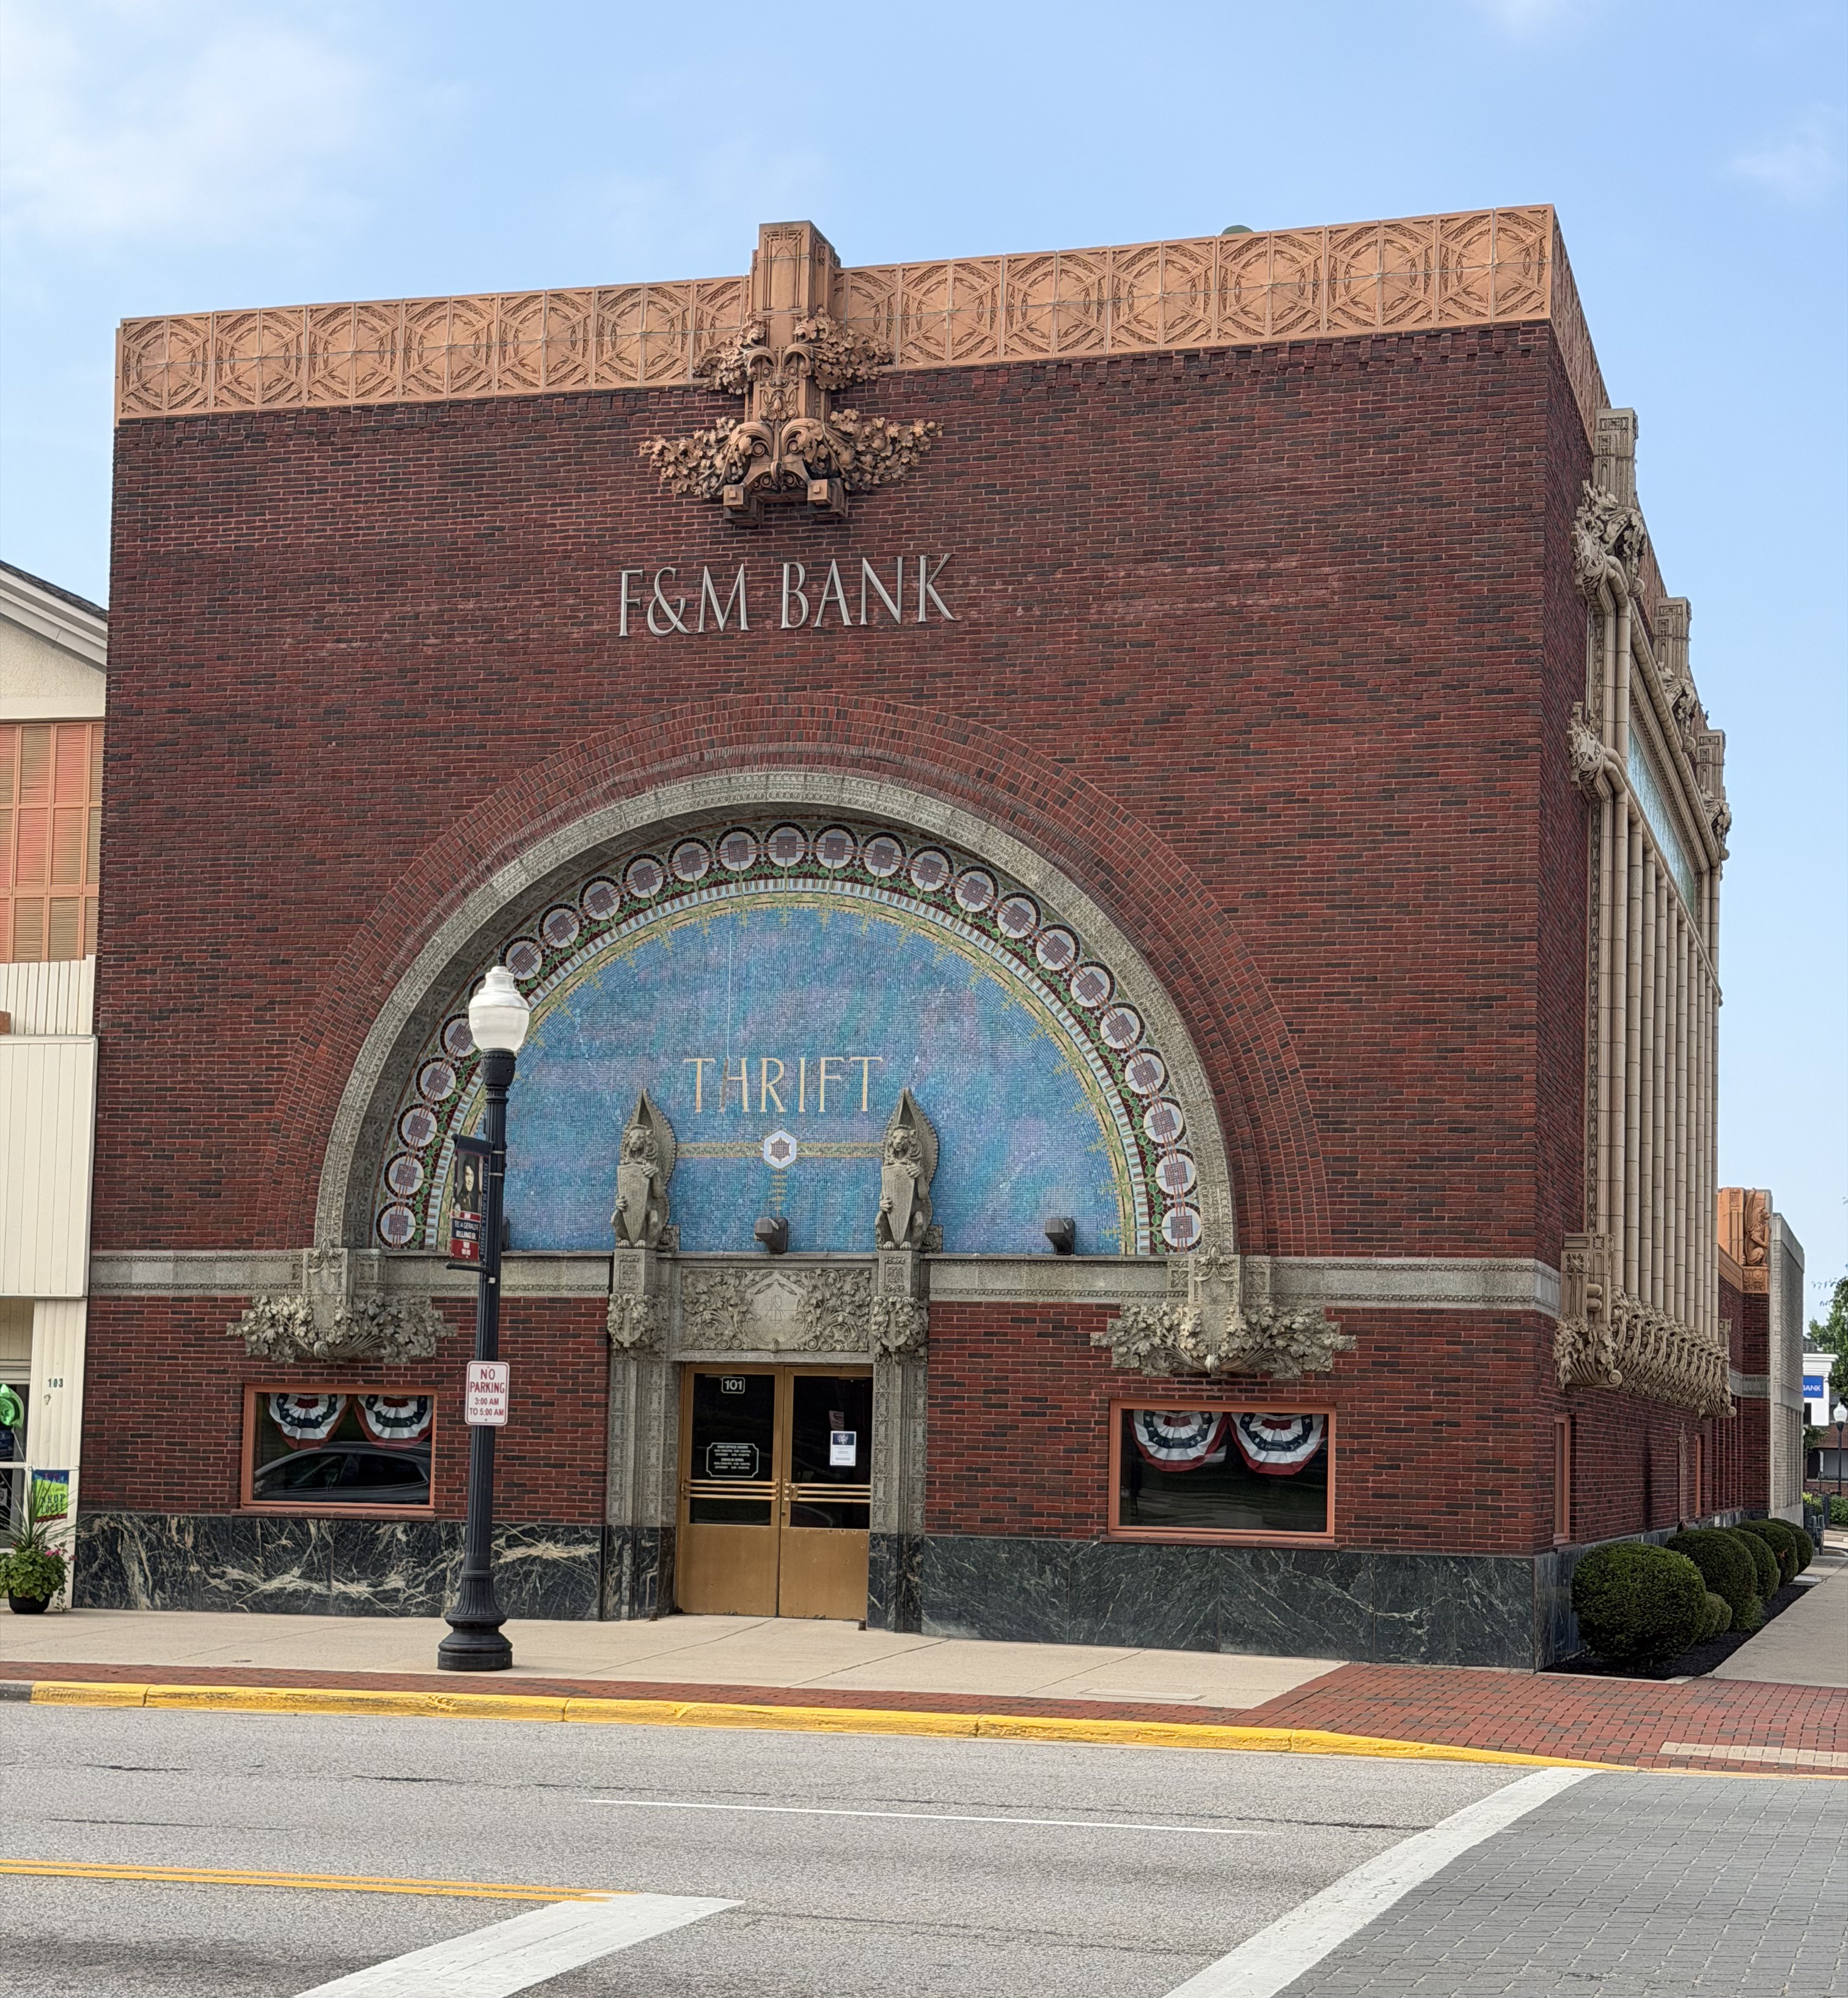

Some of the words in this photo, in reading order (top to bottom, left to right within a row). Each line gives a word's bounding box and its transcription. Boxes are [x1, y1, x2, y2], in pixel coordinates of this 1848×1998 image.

[618, 563, 754, 637] F&M
[780, 553, 961, 631] BANK
[683, 1056, 884, 1113] THRIFT
[480, 1368, 496, 1380] NO
[48, 1378, 64, 1388] 103
[469, 1381, 505, 1394] PARKING
[724, 1379, 743, 1390] 101
[480, 1408, 493, 1416] 5:00
